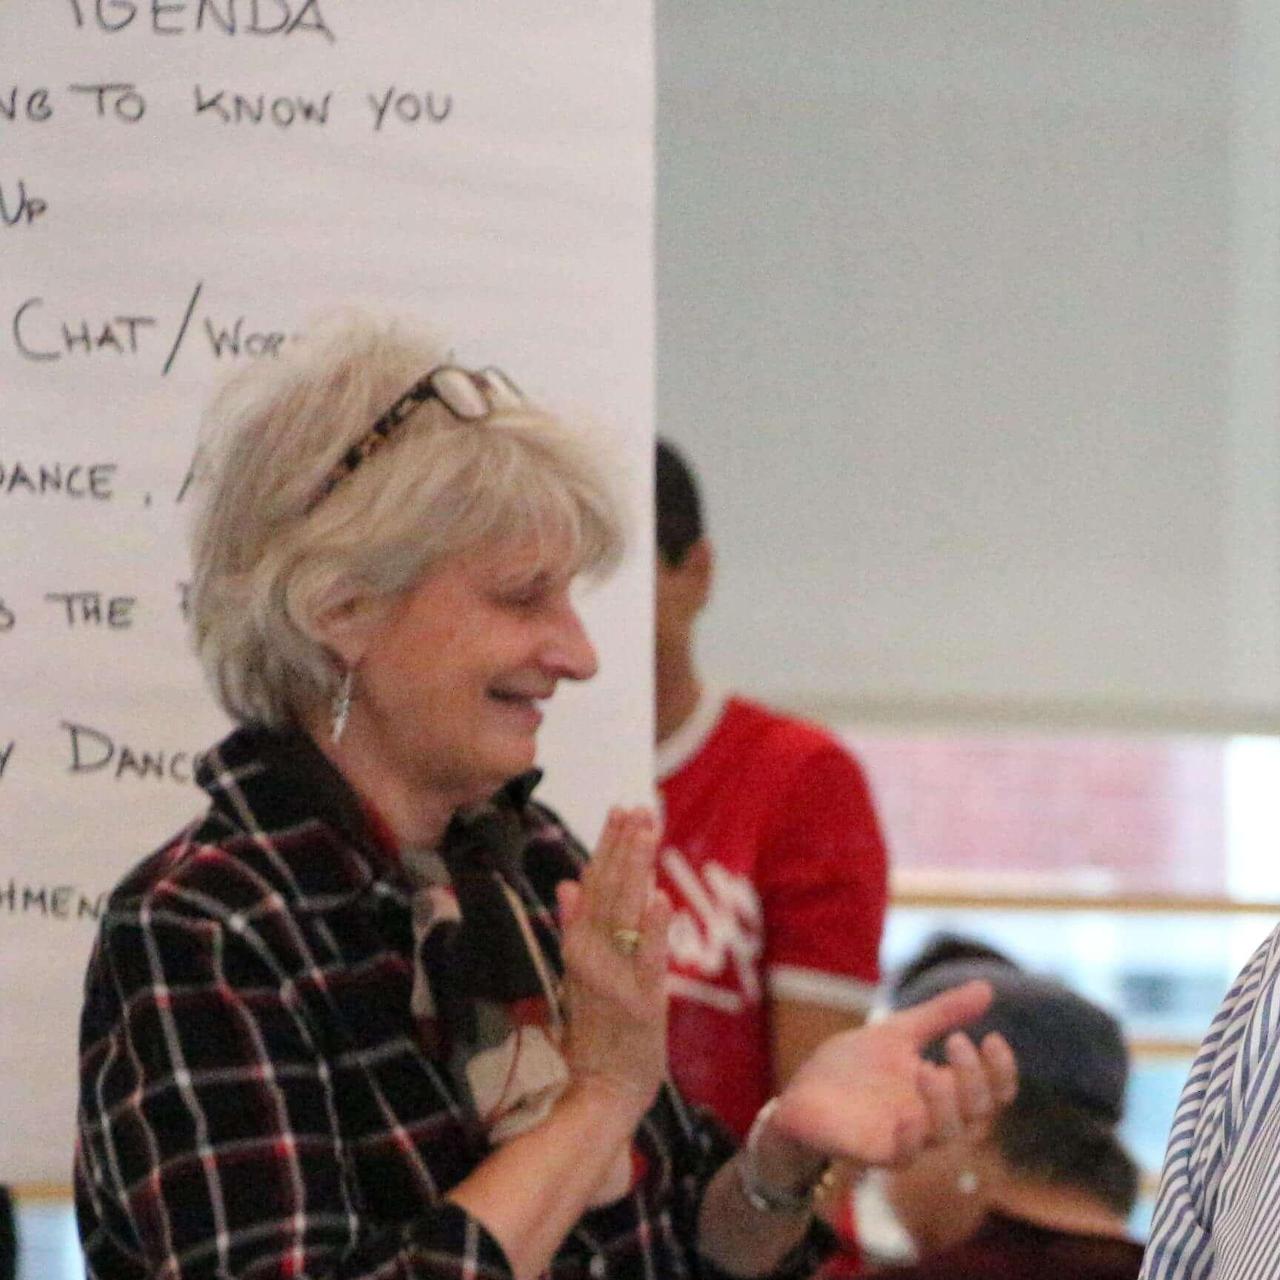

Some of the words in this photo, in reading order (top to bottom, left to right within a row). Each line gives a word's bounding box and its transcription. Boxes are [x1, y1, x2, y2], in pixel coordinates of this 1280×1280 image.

[67, 83, 146, 124] TO
[194, 84, 333, 127] KNOW
[368, 85, 453, 131] YOU
[0, 462, 118, 501] ANCE
[45, 591, 138, 629] THE
[60, 719, 192, 785] DANC
